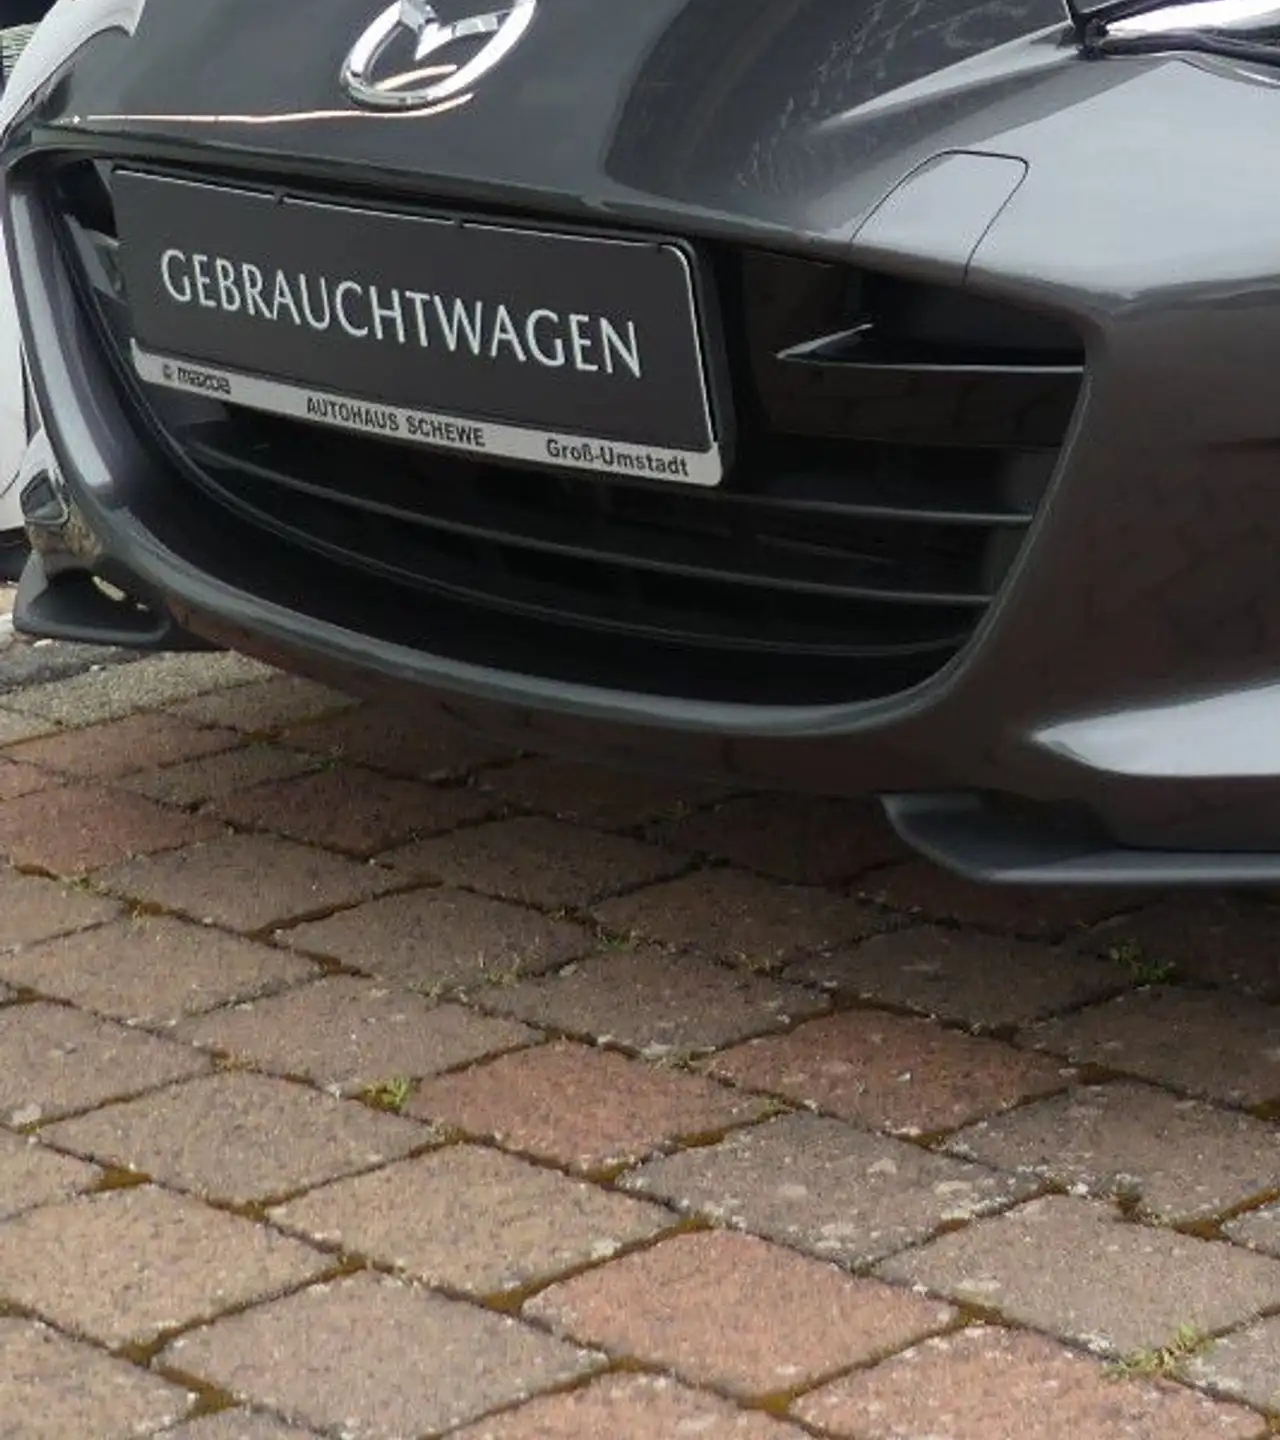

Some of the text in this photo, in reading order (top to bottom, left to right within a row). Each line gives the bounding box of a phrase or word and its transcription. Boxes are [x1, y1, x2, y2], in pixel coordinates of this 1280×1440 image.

[160, 249, 642, 378] GEBRAUCHTWAGEN
[306, 396, 486, 447] AUTOHAUS SCHEWE
[546, 438, 689, 476] Groß-Umstadt
